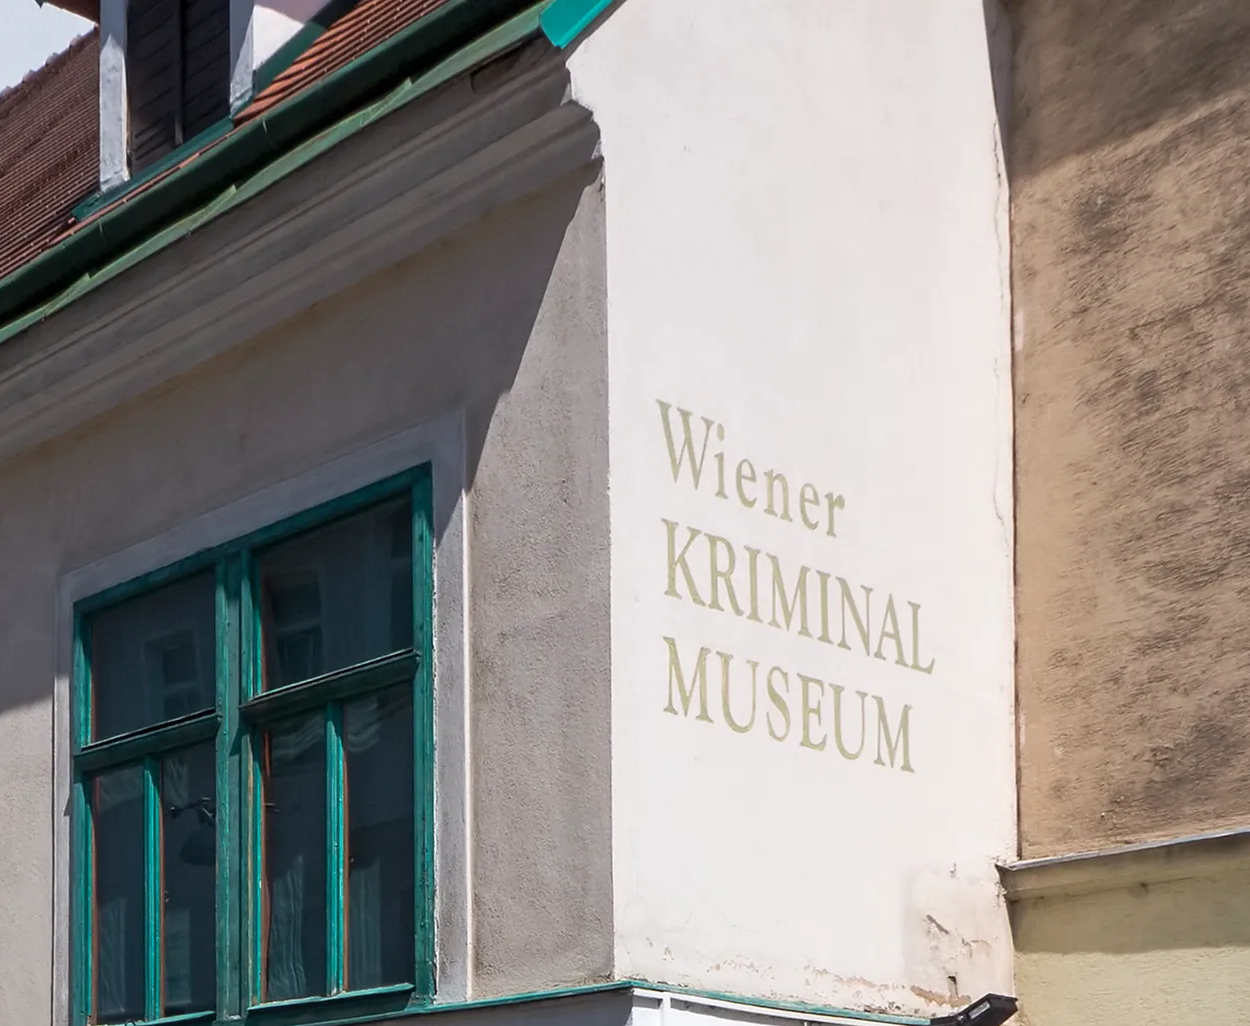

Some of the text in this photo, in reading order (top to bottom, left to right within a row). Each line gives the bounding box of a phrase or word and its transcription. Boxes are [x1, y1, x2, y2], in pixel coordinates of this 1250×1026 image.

[656, 398, 845, 538] Wiener
[660, 517, 936, 675] KRIMINAL
[662, 635, 915, 773] MUSEUM
